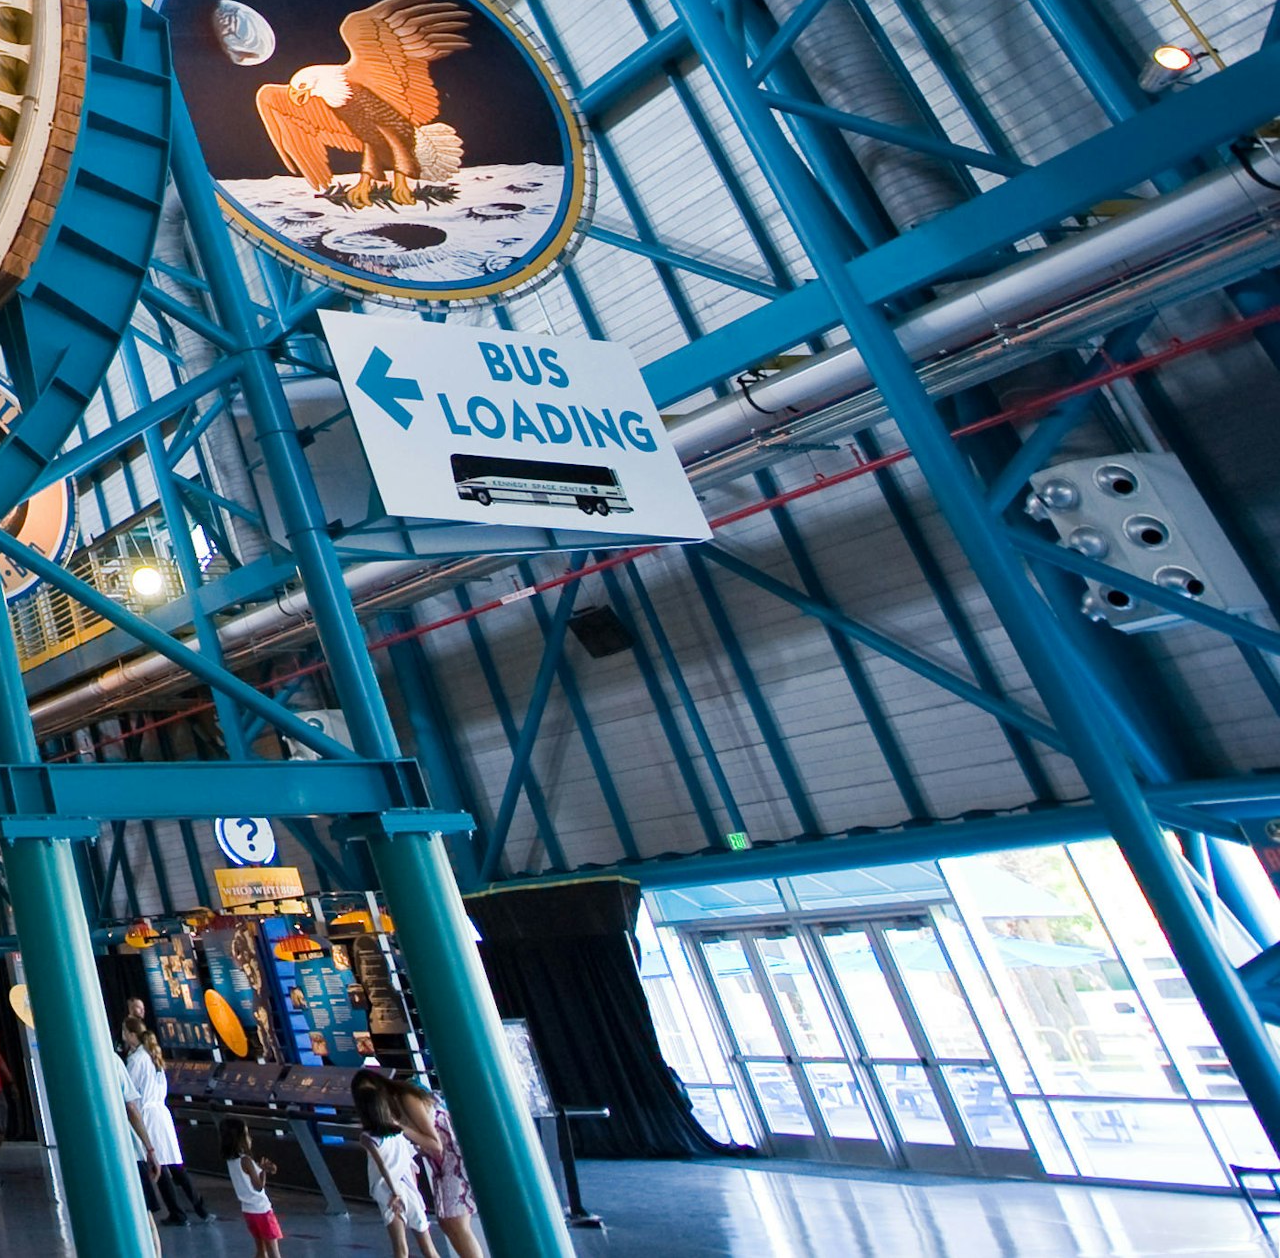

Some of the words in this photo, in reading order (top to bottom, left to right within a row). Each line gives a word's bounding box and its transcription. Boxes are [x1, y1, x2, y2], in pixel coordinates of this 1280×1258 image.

[478, 341, 570, 388] BUS
[437, 393, 658, 453] LOADING
[492, 479, 528, 490] KENNEDY
[532, 483, 557, 491] SPACE
[560, 484, 589, 493] CENTER
